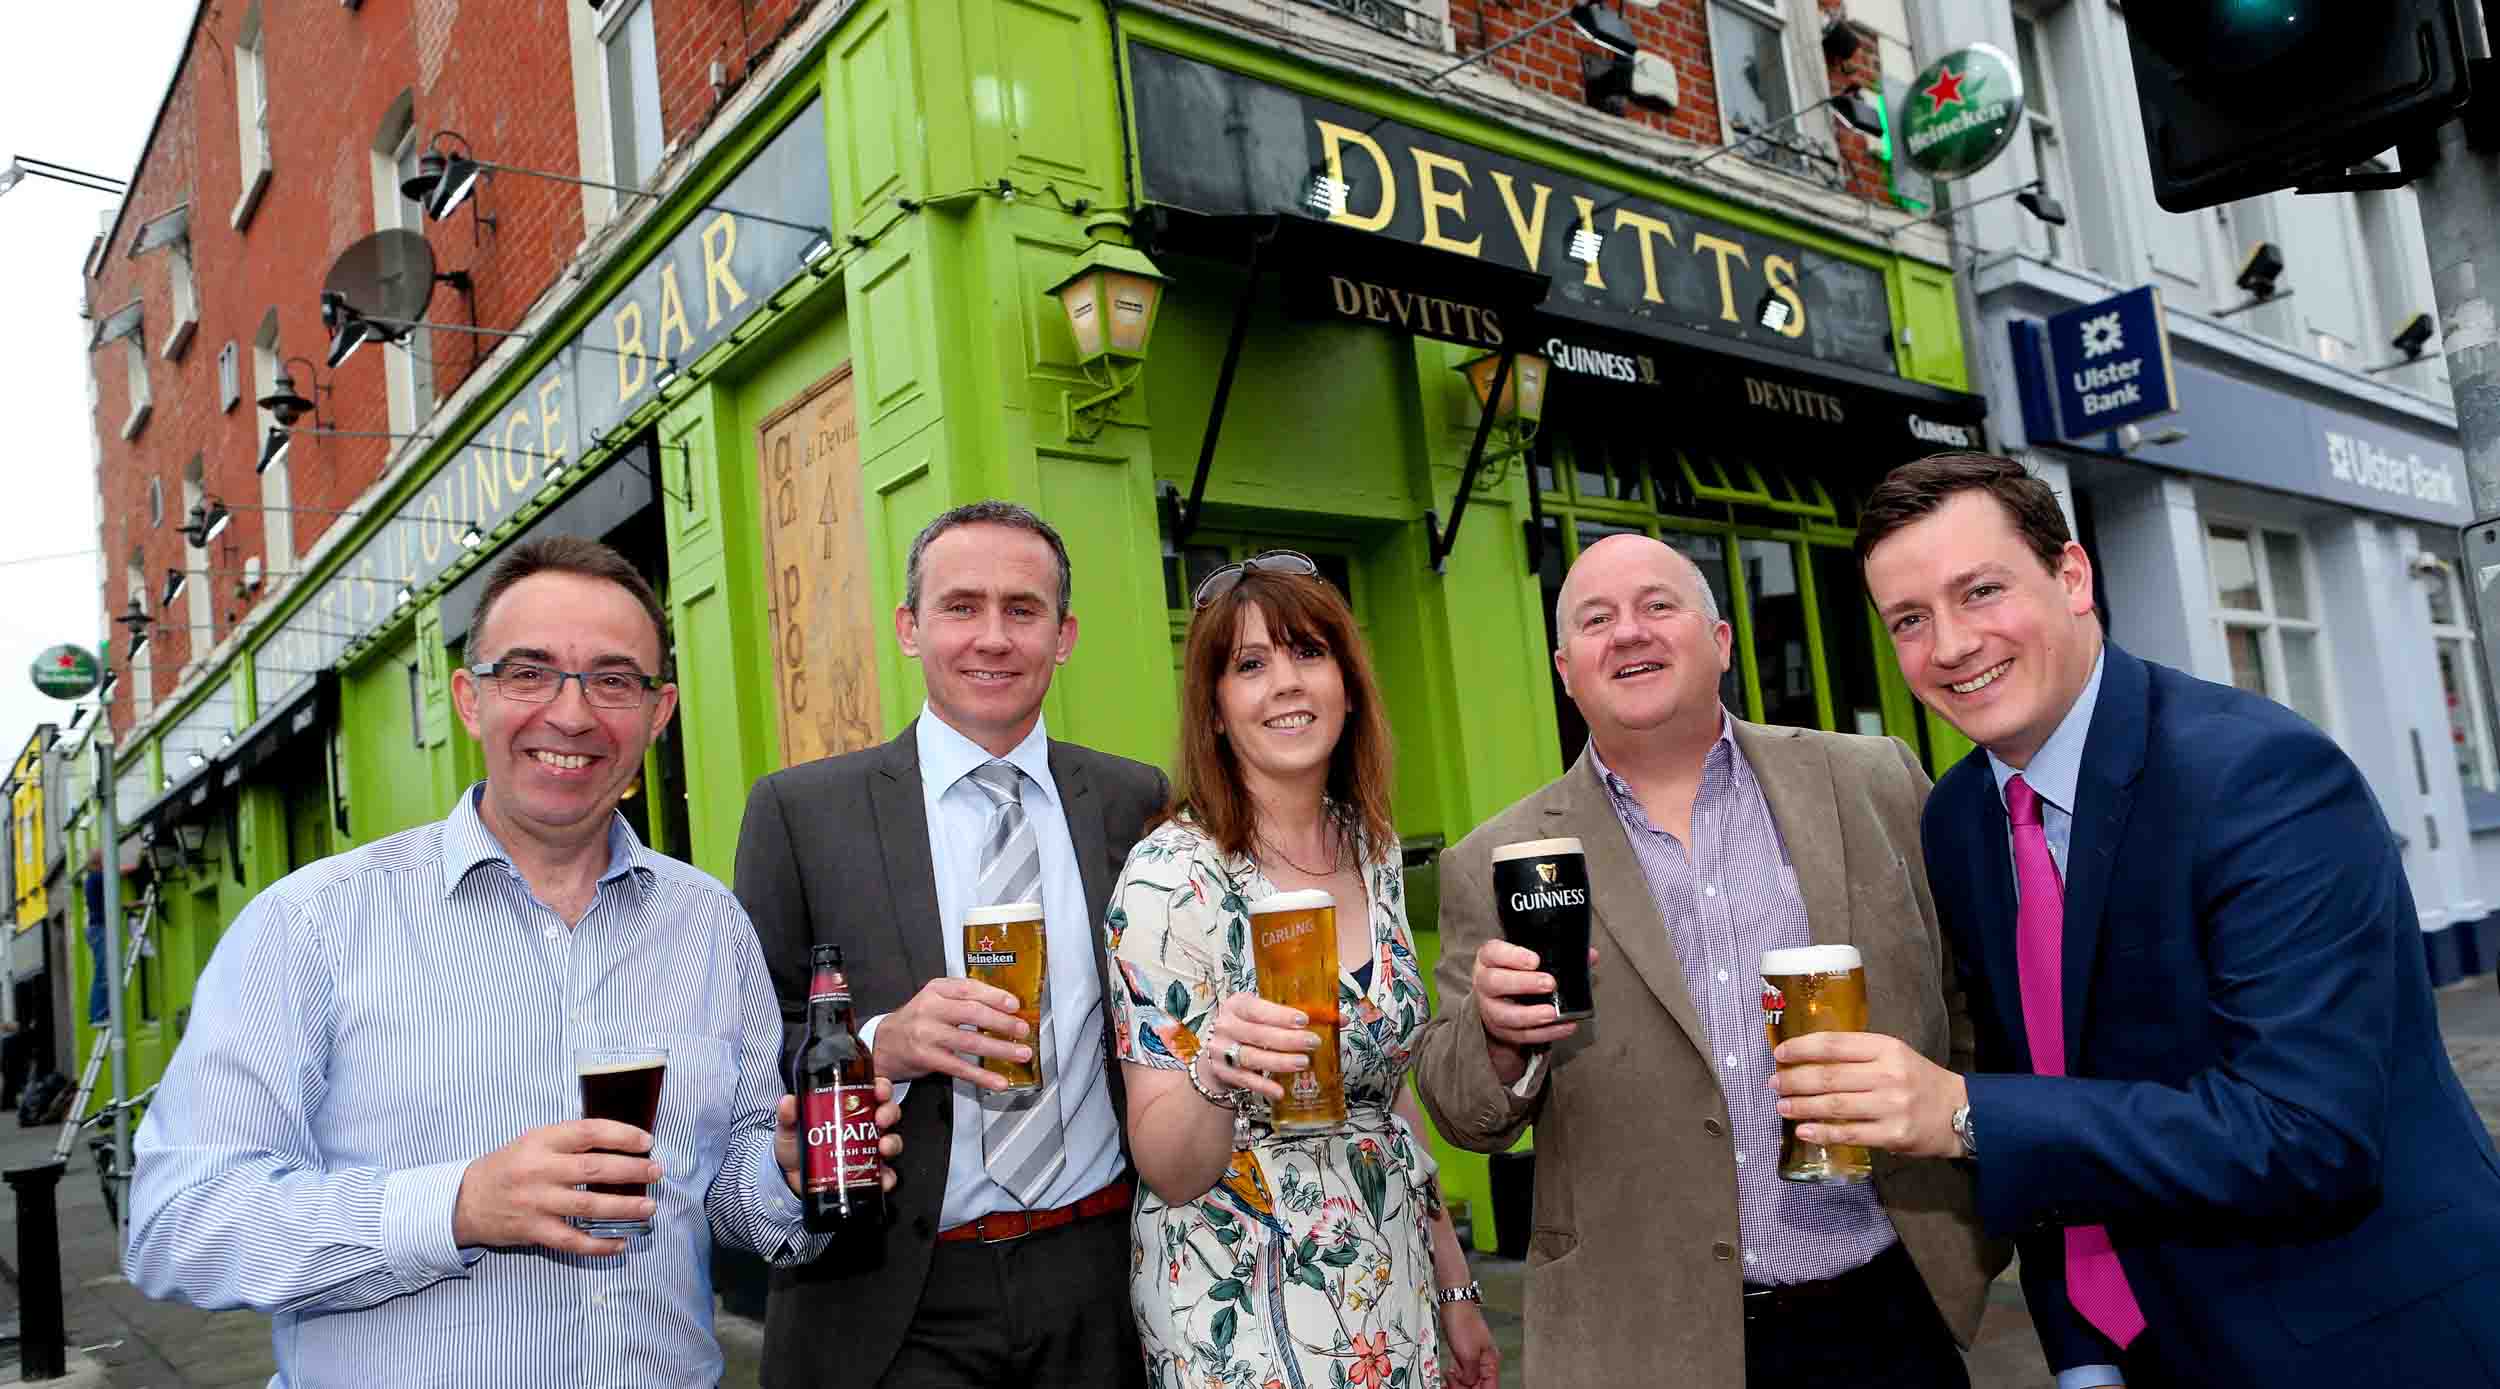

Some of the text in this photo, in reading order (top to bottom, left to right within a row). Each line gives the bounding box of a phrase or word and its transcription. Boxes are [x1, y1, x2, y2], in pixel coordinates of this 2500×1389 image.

[1906, 102, 2006, 155] Heineken
[1314, 118, 1806, 338] DEVITTS
[1329, 274, 1504, 345] DEVITTS
[1546, 337, 1637, 383] GUINNESS
[2073, 358, 2142, 393] Ulster
[398, 374, 568, 584] LOUNGE
[613, 211, 749, 402] BAR
[1744, 377, 1845, 424] DEVITTS
[2082, 382, 2141, 417] Bank
[2349, 439, 2457, 505] Ulster Bank
[1511, 888, 1585, 912] GUINNESS
[1261, 919, 1315, 947] CARLING
[967, 952, 1014, 963] Heineken
[862, 1146, 877, 1155] RED
